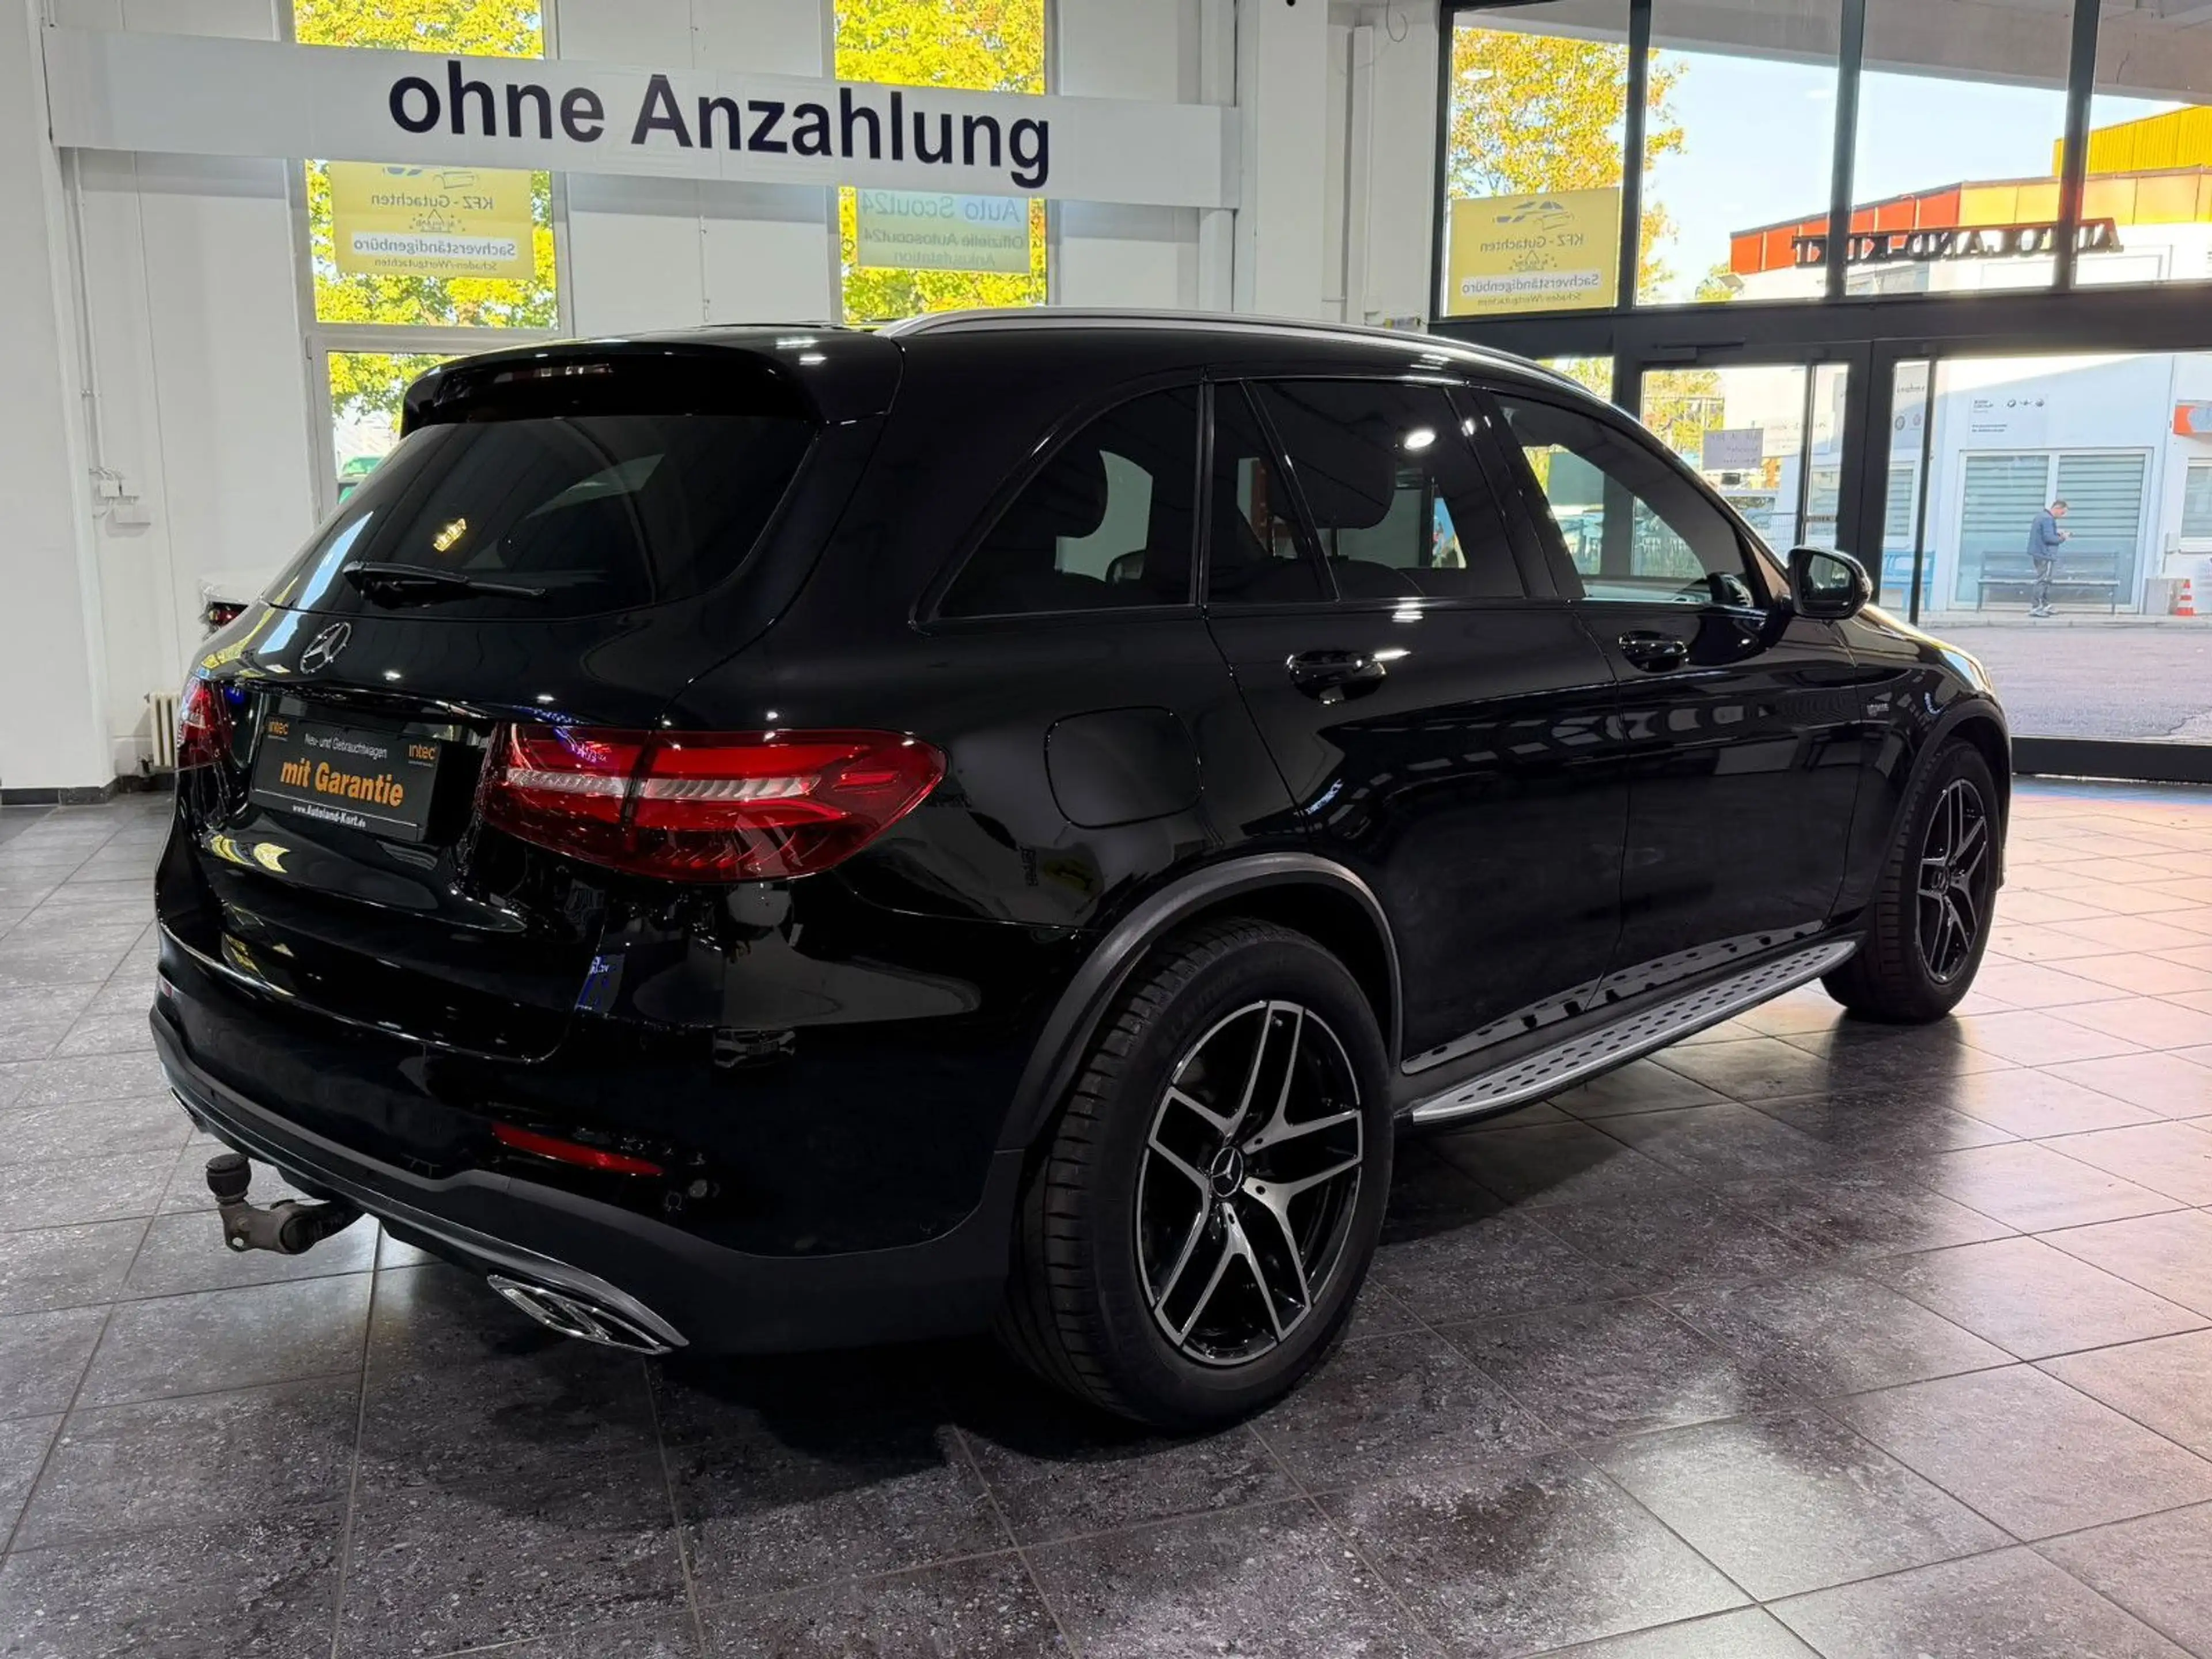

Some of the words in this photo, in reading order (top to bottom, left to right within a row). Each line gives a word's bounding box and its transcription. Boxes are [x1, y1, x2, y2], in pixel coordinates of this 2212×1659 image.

[389, 59, 606, 143] ohne
[631, 74, 1050, 189] Anzahlung
[319, 737, 332, 749] und
[281, 757, 311, 787] mit
[315, 762, 403, 807] Garantie
